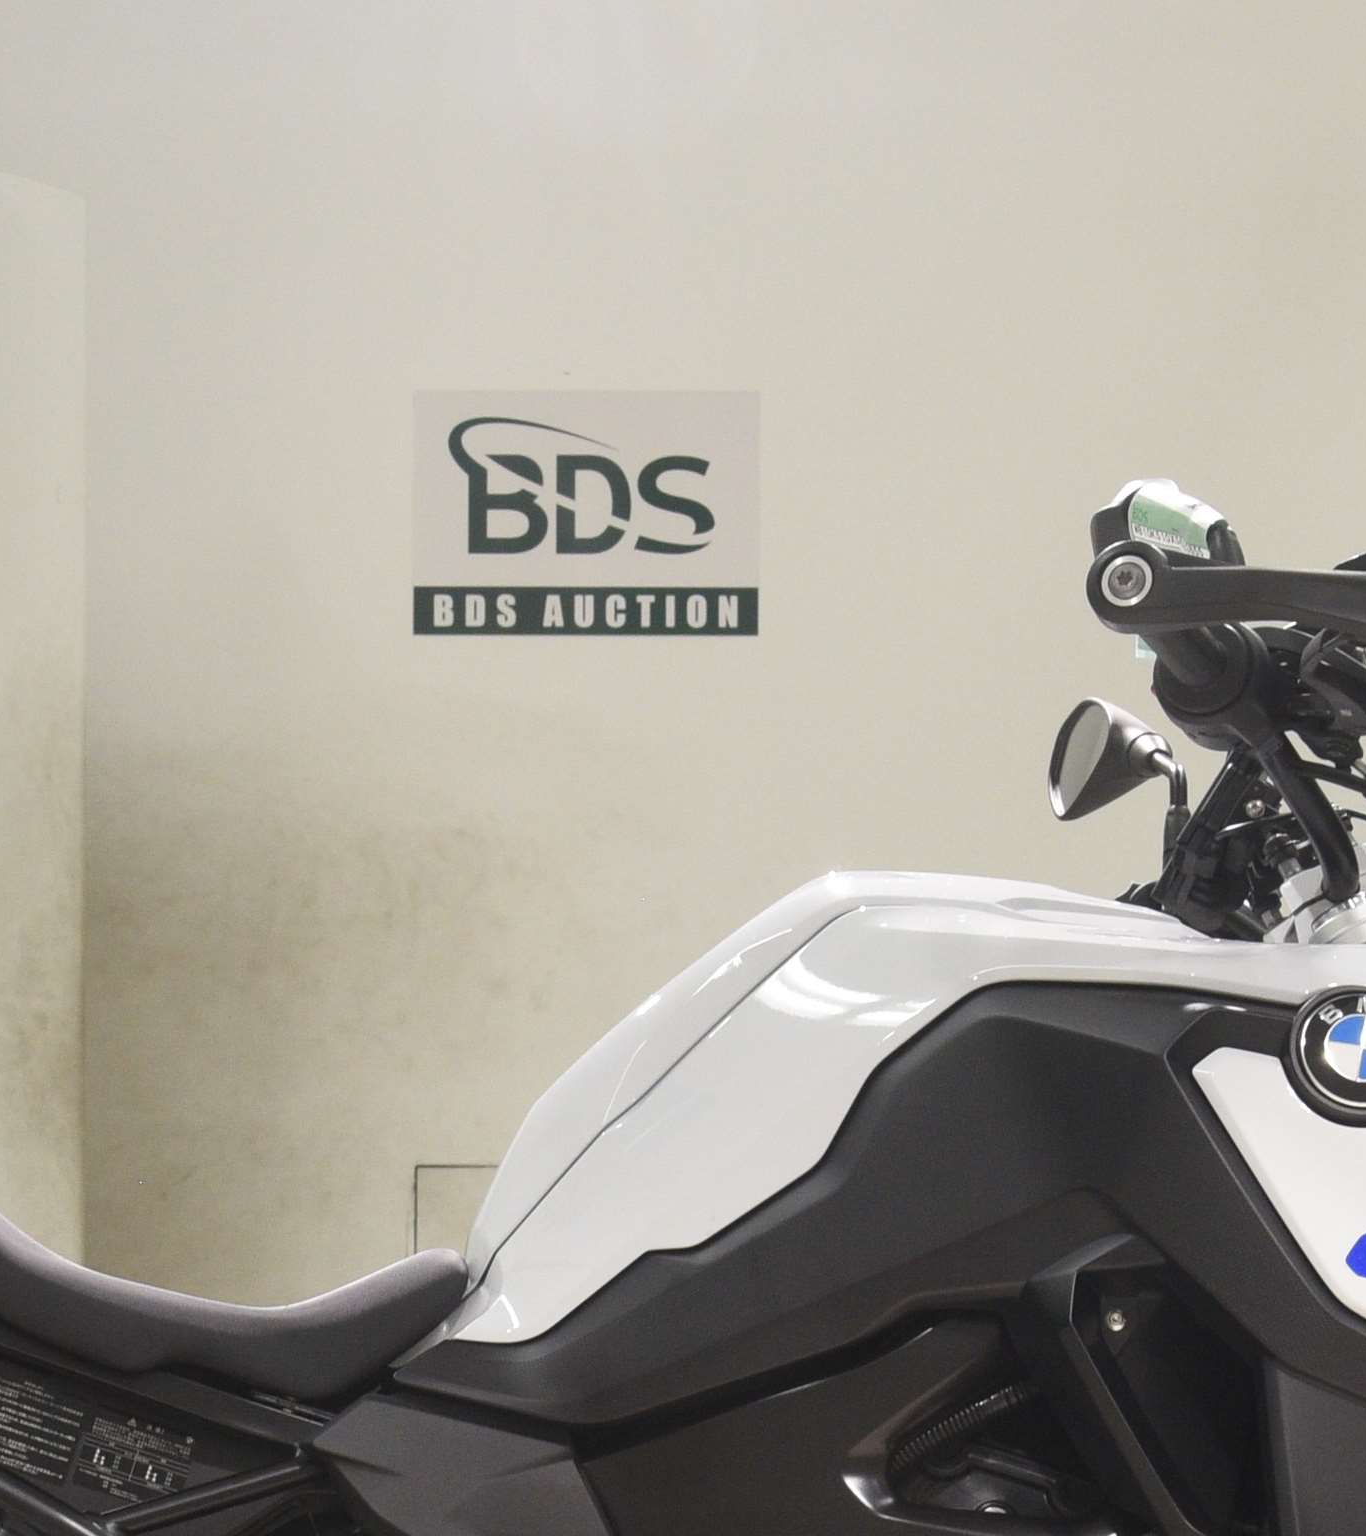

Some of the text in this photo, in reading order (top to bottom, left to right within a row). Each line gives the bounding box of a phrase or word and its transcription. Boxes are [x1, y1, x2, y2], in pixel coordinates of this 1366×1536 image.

[448, 417, 715, 554] BDS
[432, 593, 739, 628] BDS AUCTION
